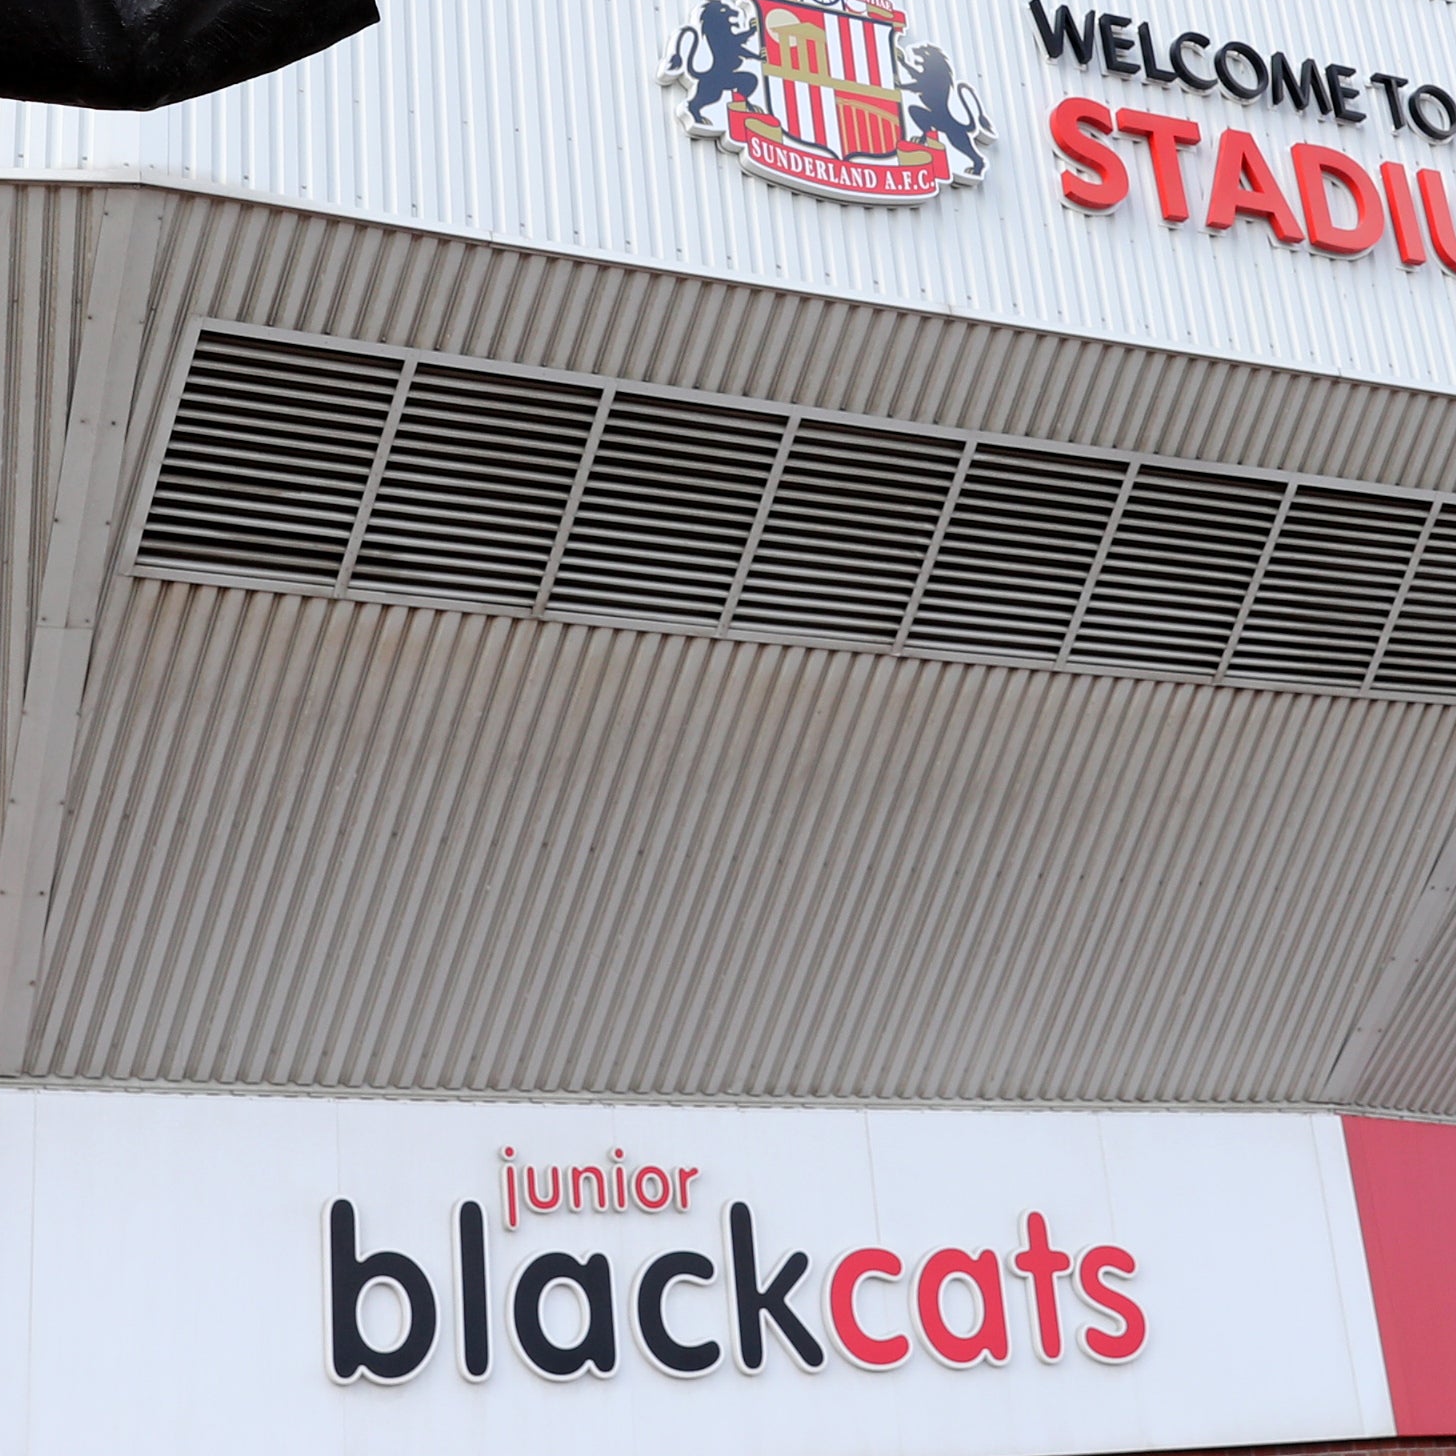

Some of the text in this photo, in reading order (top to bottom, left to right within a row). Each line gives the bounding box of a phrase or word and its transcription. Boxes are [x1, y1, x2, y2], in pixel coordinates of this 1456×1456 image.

[751, 136, 936, 191] SUNDERLAND A.F.C.
[500, 1146, 699, 1231] junior
